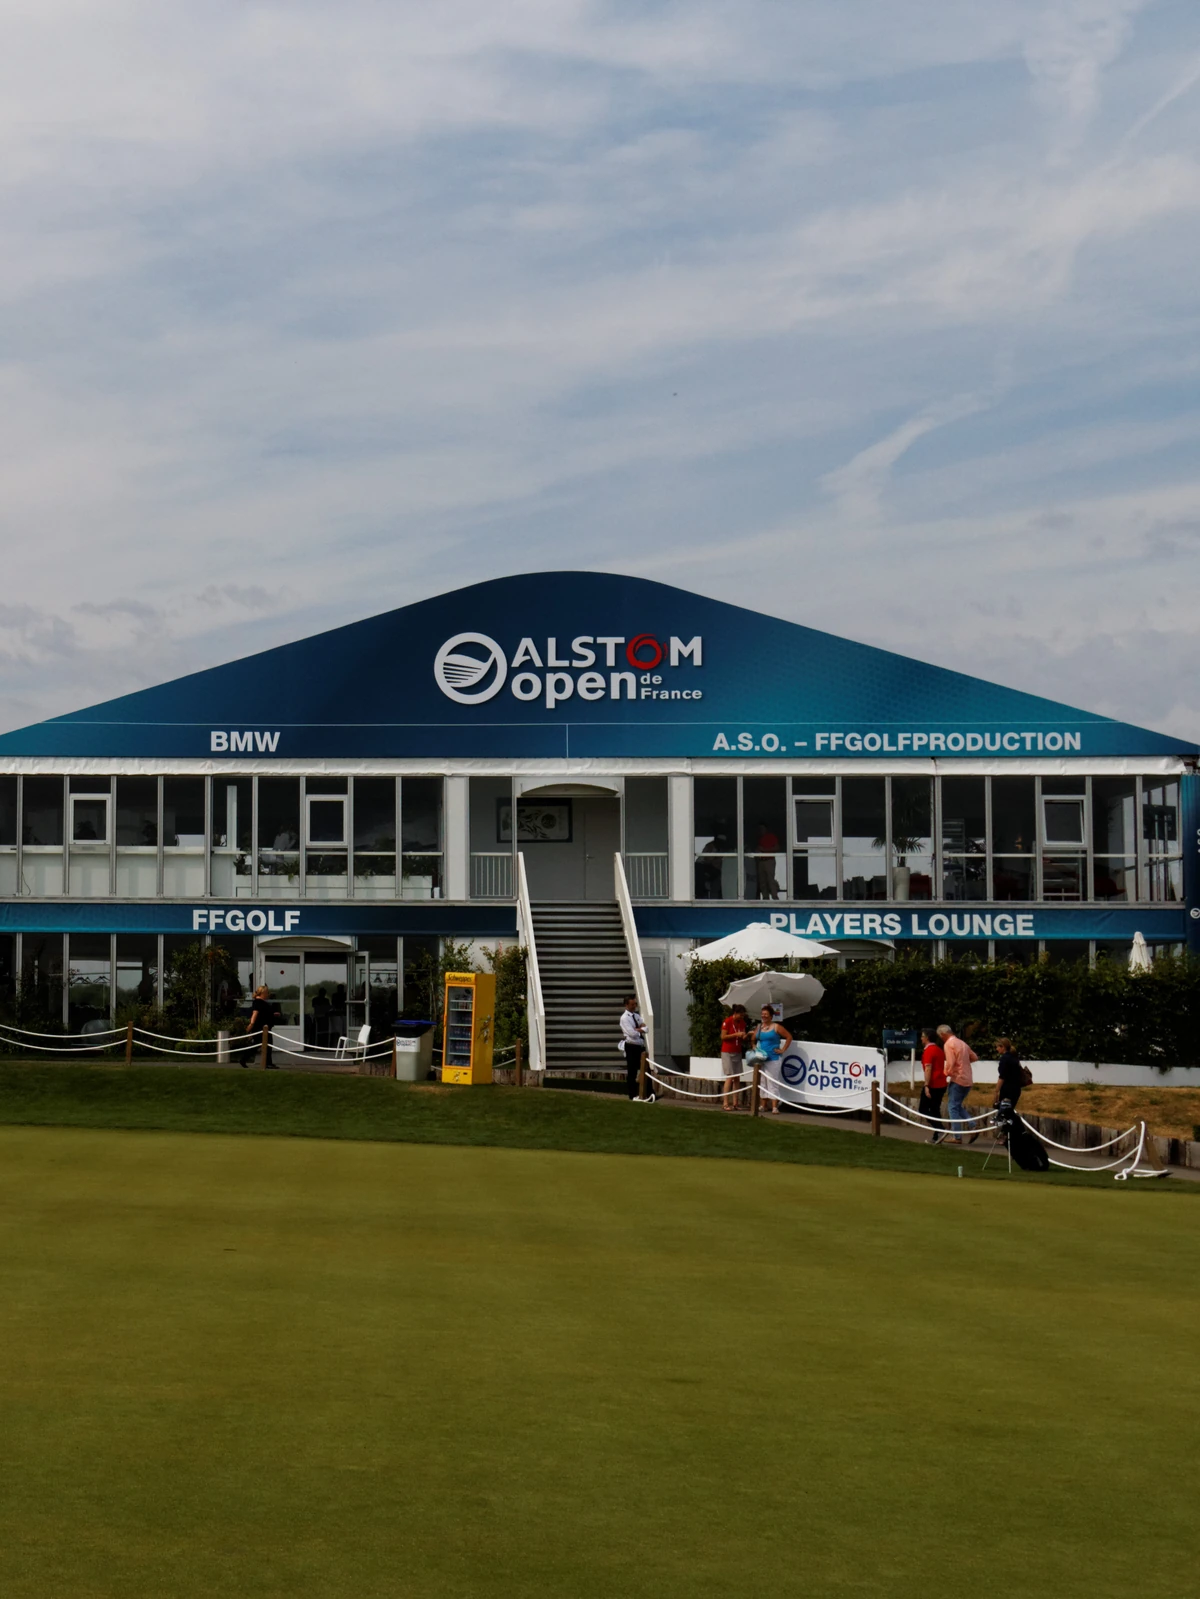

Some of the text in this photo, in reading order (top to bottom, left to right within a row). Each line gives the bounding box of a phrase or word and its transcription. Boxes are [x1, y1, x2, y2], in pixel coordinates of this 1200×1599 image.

[511, 633, 702, 670] ALSTOM
[511, 670, 636, 708] open
[641, 673, 662, 685] de
[641, 688, 702, 700] France
[210, 731, 281, 752] BMW
[712, 732, 787, 752] A.S.O.
[815, 732, 1081, 752] FFGOLFPRODUCTION
[193, 909, 301, 932] FFGOLF
[770, 913, 1036, 936] PLAYERS LOUNGE
[808, 1060, 876, 1077] ALSTOM
[808, 1074, 853, 1090] open
